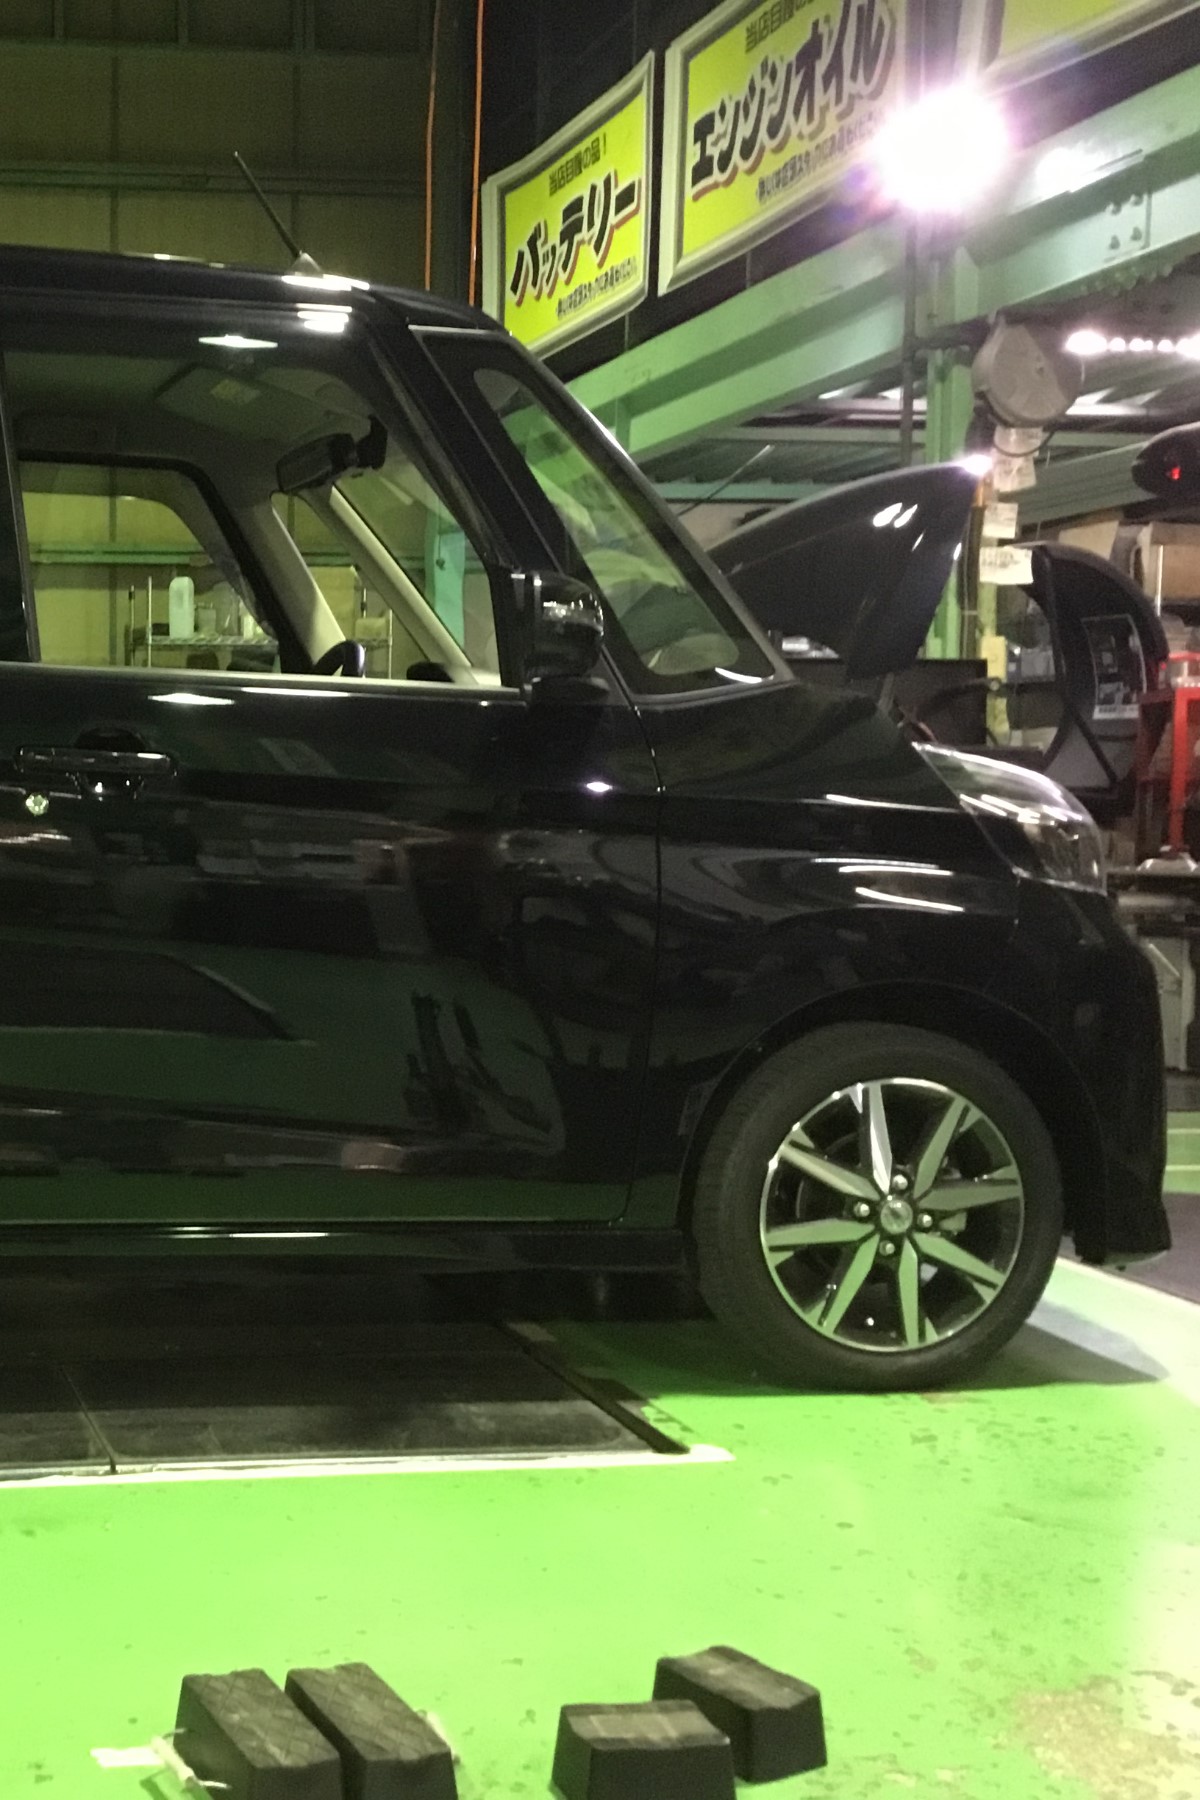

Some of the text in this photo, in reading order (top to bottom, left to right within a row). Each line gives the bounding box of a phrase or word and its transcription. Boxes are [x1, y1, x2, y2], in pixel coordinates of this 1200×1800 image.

[690, 0, 894, 192] エンジンオイル
[509, 171, 642, 303] バッテリー
